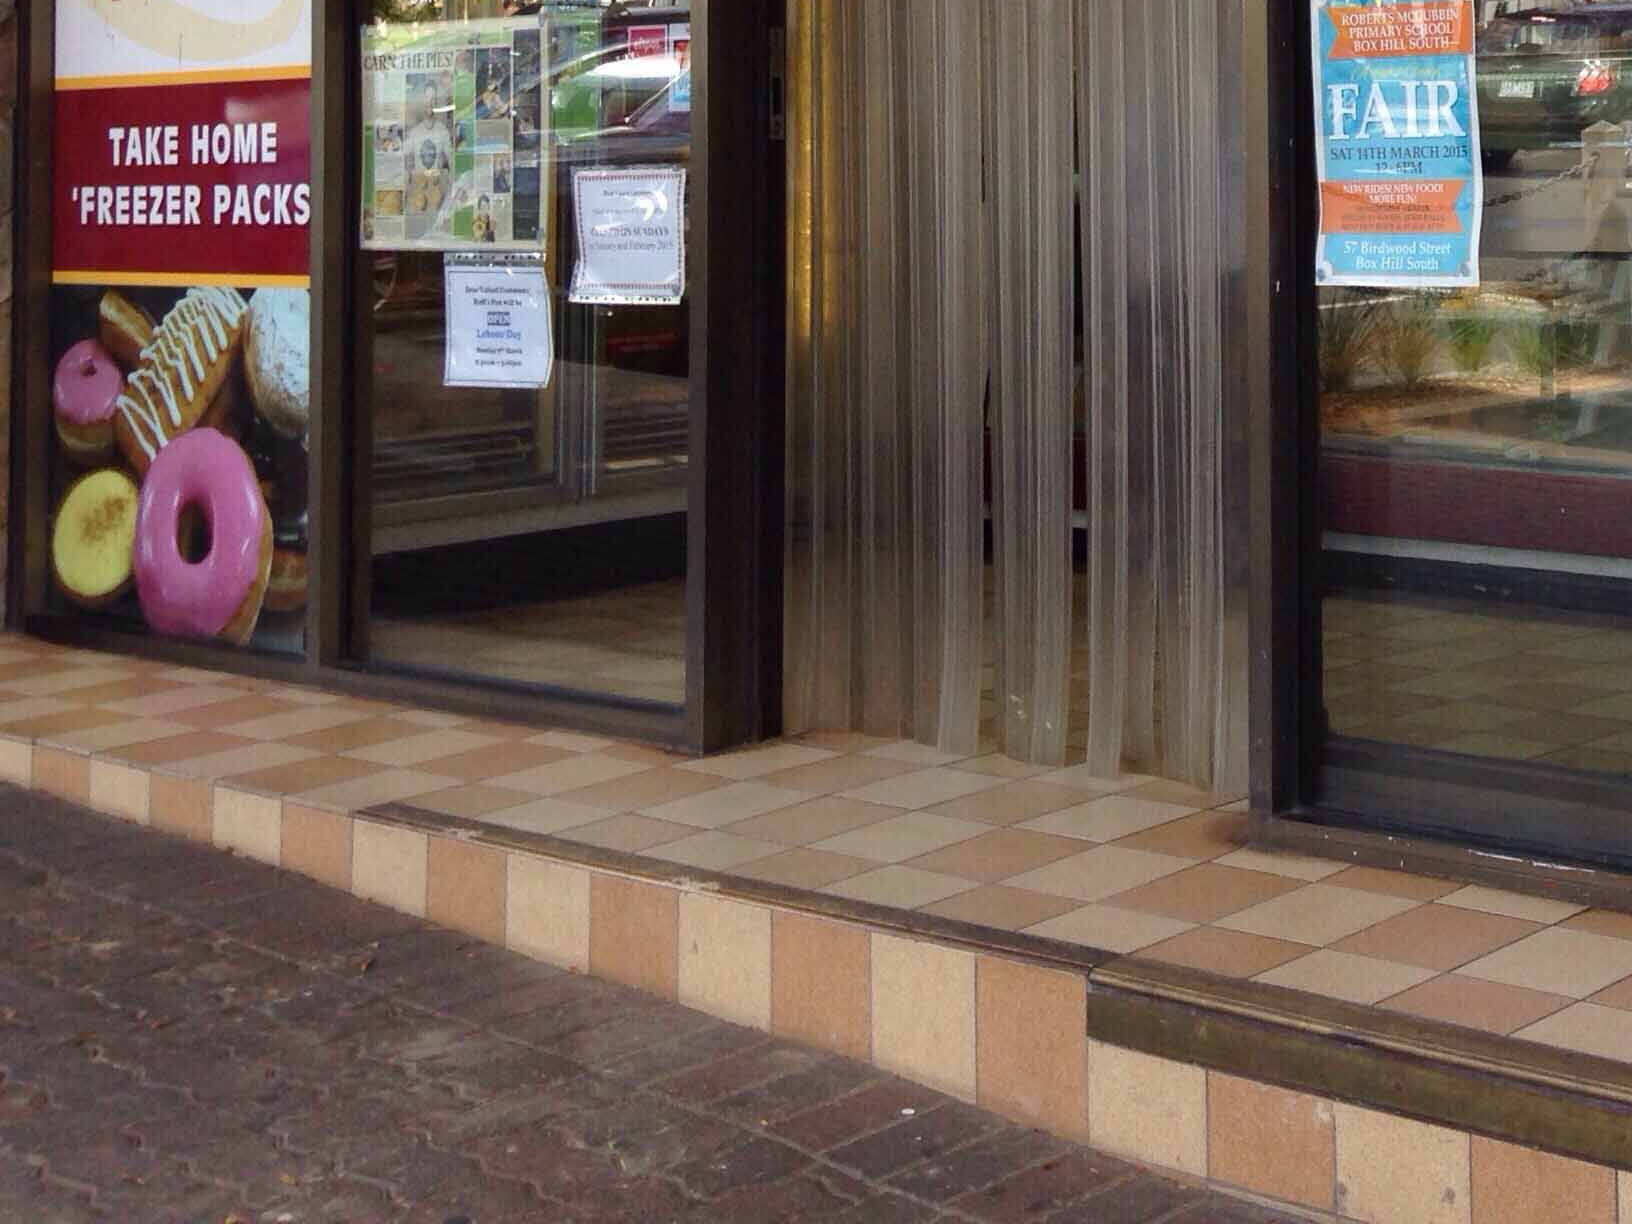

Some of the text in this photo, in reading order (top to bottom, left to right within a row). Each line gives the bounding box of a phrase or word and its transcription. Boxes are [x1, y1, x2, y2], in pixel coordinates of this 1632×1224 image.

[1342, 12, 1395, 26] ROBERTS
[1349, 22, 1455, 39] PRIMARY SCHOOL
[1354, 40, 1379, 52] BOX
[1381, 38, 1407, 51] HILL
[1327, 79, 1467, 141] FAIR
[108, 121, 277, 167] TAKE HOME
[1330, 148, 1355, 161] SAT
[1391, 145, 1440, 160] MARCH
[1443, 144, 1468, 158] 2015
[212, 182, 311, 226] PACKS
[1360, 240, 1417, 255] Birdwood
[1420, 240, 1451, 254] Street
[1355, 256, 1439, 270] Box Hill South
